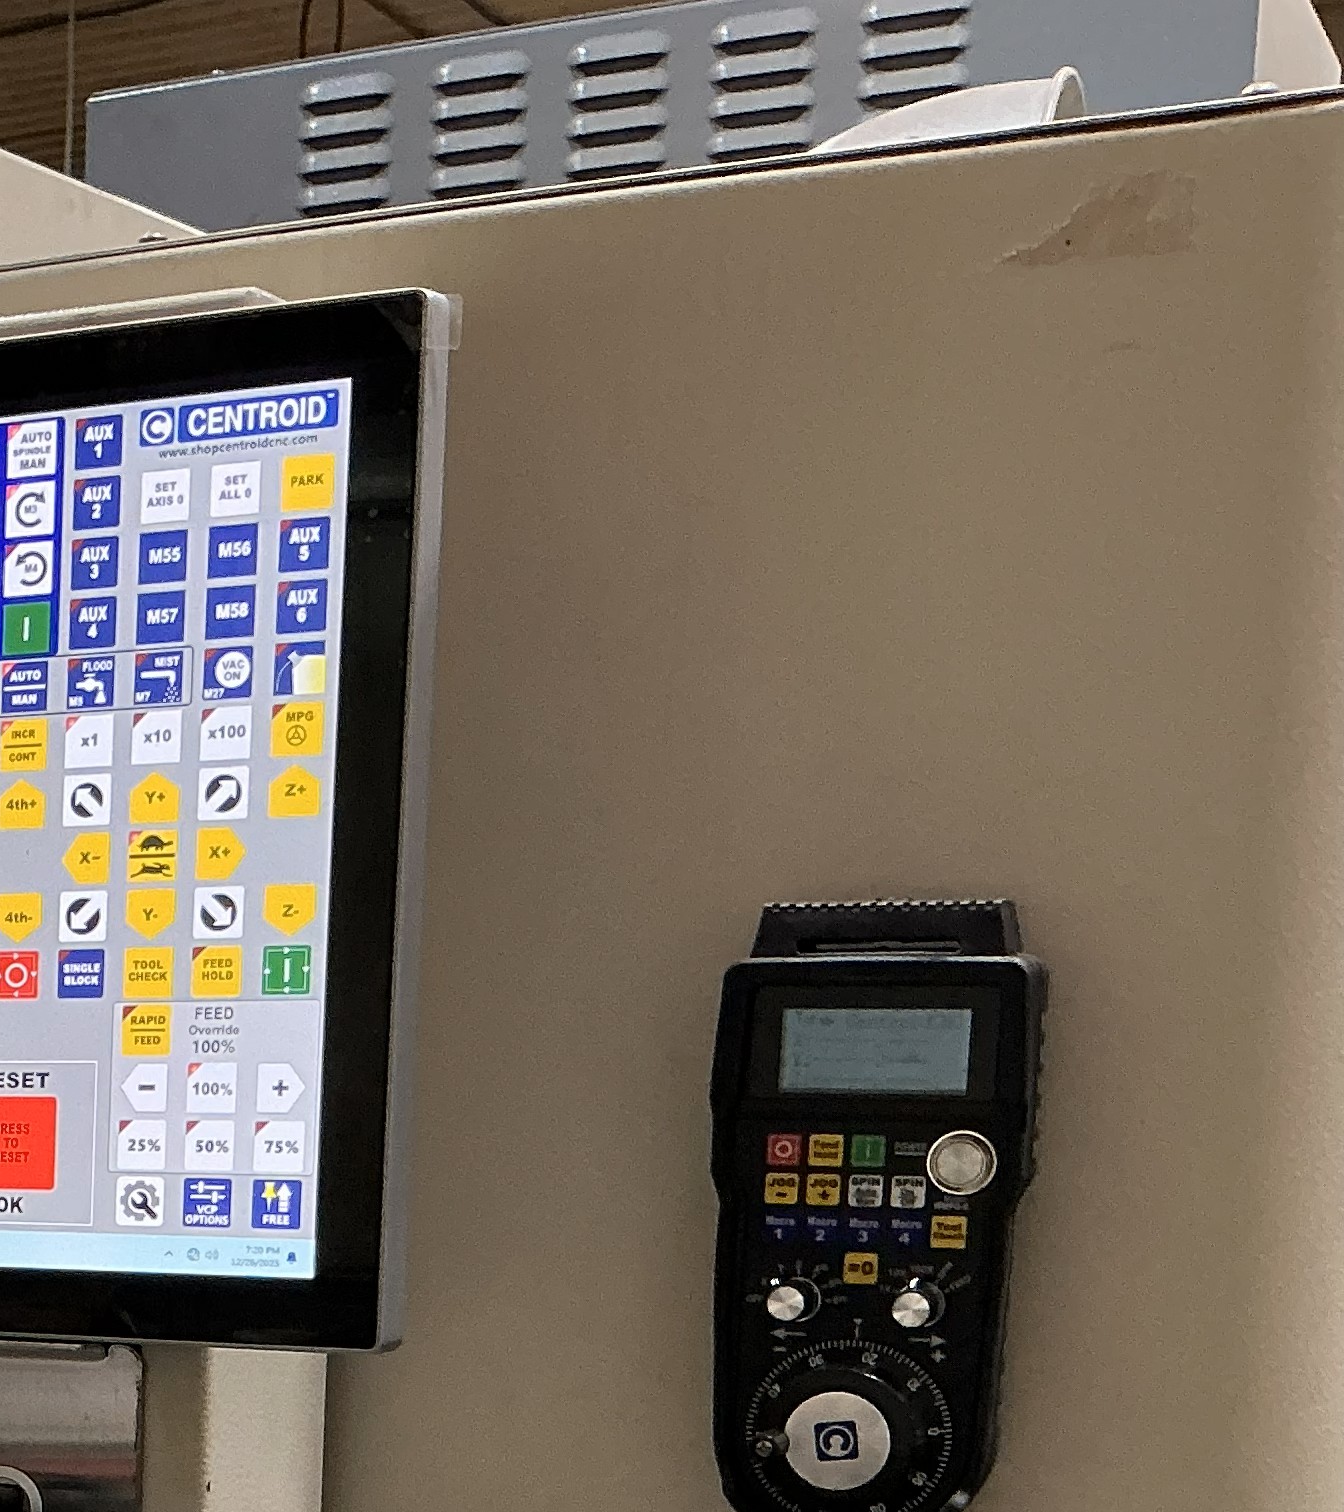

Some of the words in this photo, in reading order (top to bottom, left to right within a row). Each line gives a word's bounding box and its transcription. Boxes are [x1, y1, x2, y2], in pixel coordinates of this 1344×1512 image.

[188, 398, 327, 434] CENTROID
[84, 423, 113, 442] AUX
[159, 433, 318, 458] www.shopcentroidcnc.com
[291, 473, 324, 487] PARK
[82, 486, 111, 503] AUX
[289, 525, 321, 544] AUX
[80, 544, 110, 563] AUX
[149, 546, 181, 564] M55
[219, 541, 251, 558] M56
[287, 588, 318, 606] AUX
[78, 604, 108, 623] AUX
[147, 607, 178, 624] M57
[216, 601, 249, 619] M58
[222, 660, 244, 670] VAC
[224, 671, 241, 681] ON
[286, 711, 313, 722] MPG
[144, 729, 171, 743] x10
[208, 725, 246, 739] x100
[285, 784, 306, 796] Z+
[6, 799, 36, 810] 4th+
[209, 846, 230, 859] X+
[62, 963, 100, 973] SINGLE
[133, 960, 163, 970] TOOL
[203, 959, 232, 968] FEED
[63, 975, 98, 985] BLOCK
[129, 972, 167, 981] CHECK
[202, 971, 233, 980] HOLD
[195, 1007, 233, 1020] FEED
[193, 1040, 235, 1053] 100%
[193, 1082, 232, 1095] 100%
[128, 1139, 160, 1151] 25%
[196, 1140, 229, 1153] 50%
[264, 1141, 298, 1153] 75%
[261, 1213, 290, 1225] FREE
